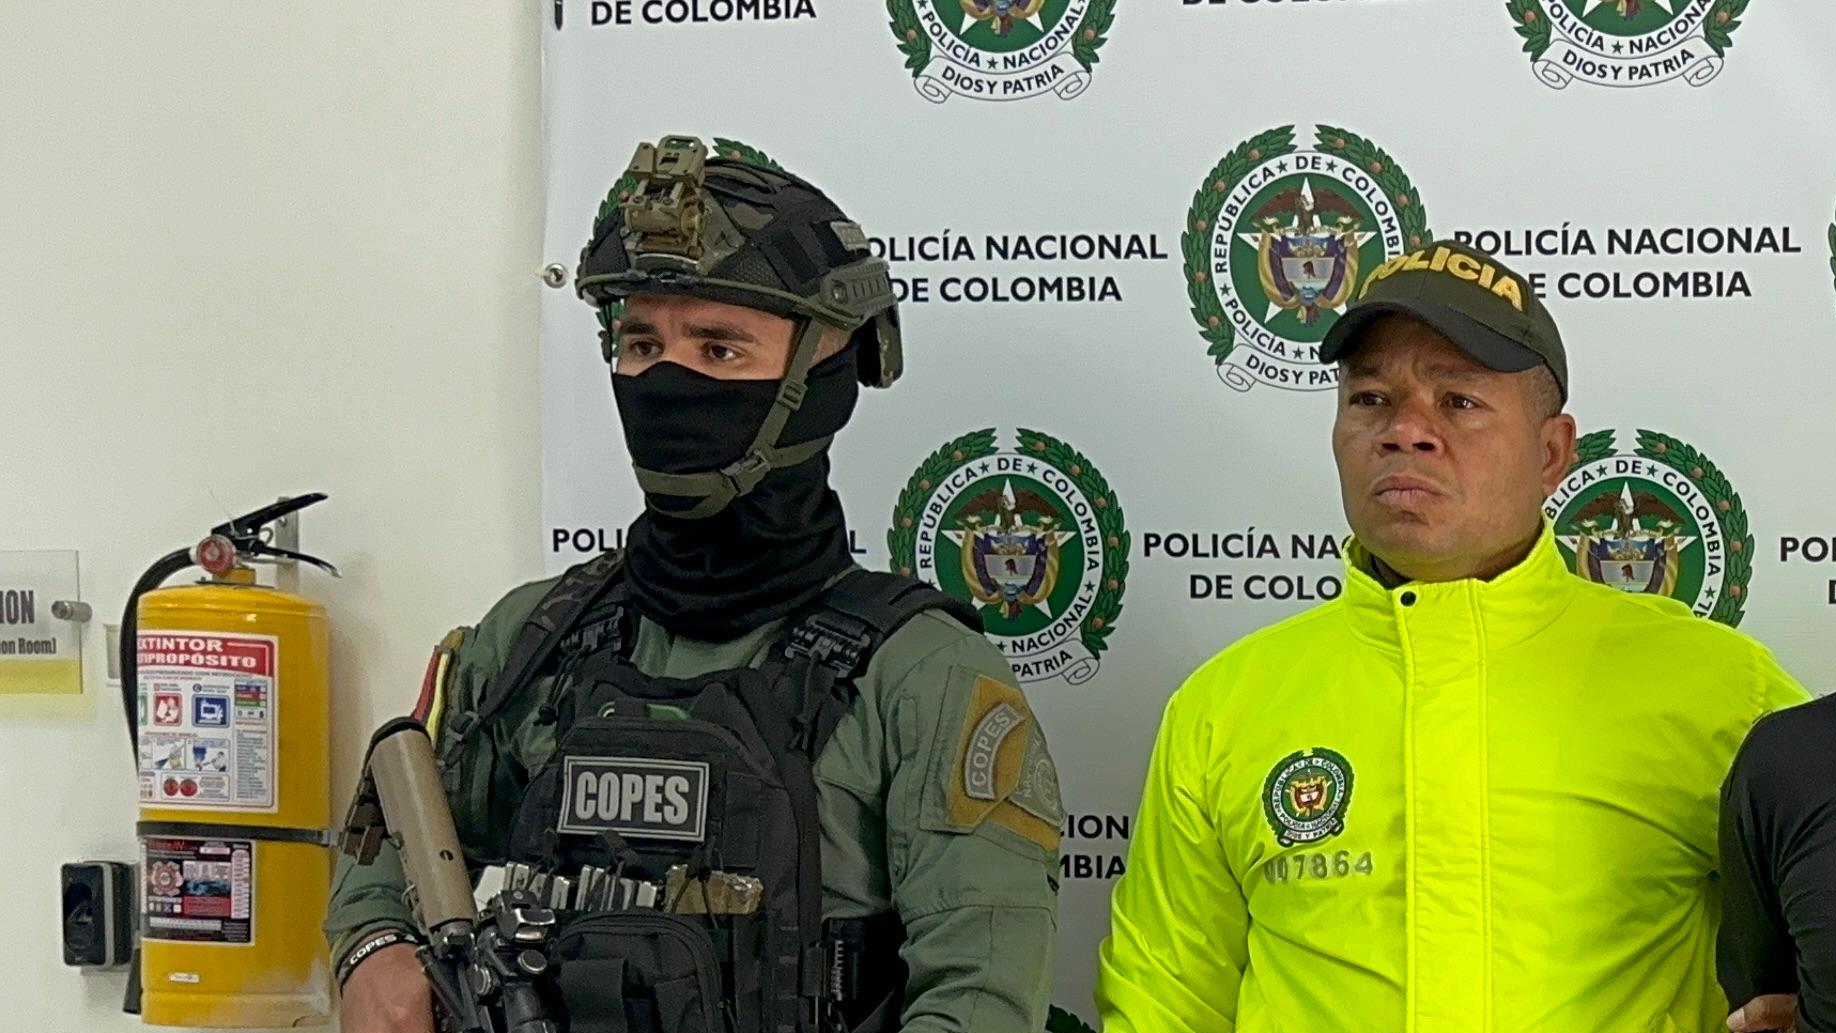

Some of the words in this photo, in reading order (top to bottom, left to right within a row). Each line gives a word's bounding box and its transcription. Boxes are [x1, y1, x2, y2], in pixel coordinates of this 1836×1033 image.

[592, 1, 631, 25] DE
[642, 0, 816, 24] COLOMBIA
[1549, 0, 1604, 51] OLICÍA
[1629, 0, 1705, 54] NACION
[922, 11, 980, 67] POLICÍA
[1003, 6, 1084, 69] NACIONAL
[942, 66, 983, 92] DIOS
[987, 81, 997, 94] Y
[1003, 64, 1064, 94] PATRIA
[1563, 49, 1607, 78] DIOS
[1611, 66, 1622, 80] Y
[1629, 49, 1694, 80] PATRIA
[1296, 156, 1321, 170] DE
[1342, 167, 1400, 258] COLOMBI
[868, 229, 975, 260] OLICÍA
[986, 234, 1168, 260] NACIONAL
[1608, 227, 1801, 254] NACIONAL
[940, 277, 1122, 302] COLOMBIA
[1558, 271, 1751, 298] COLOMBIA
[1225, 298, 1285, 356] POLICÍA
[1246, 354, 1289, 382] DIOS
[1292, 370, 1303, 384] Y
[1309, 368, 1341, 384] PAT
[919, 467, 978, 568] REPÚBLICA
[998, 458, 1022, 471] DE
[1043, 469, 1099, 571] COLOMBIA
[1545, 470, 1595, 519] BLICA
[1616, 460, 1642, 474] DE
[1663, 472, 1721, 576] COLOMBIA
[553, 529, 622, 553] POLI
[1144, 527, 1280, 558] POLICÍA
[1190, 575, 1232, 599] DE
[1244, 575, 1341, 600] COLO
[1012, 595, 1092, 653] NACIONAL
[971, 712, 1011, 787] COPES
[575, 771, 690, 825] COPES
